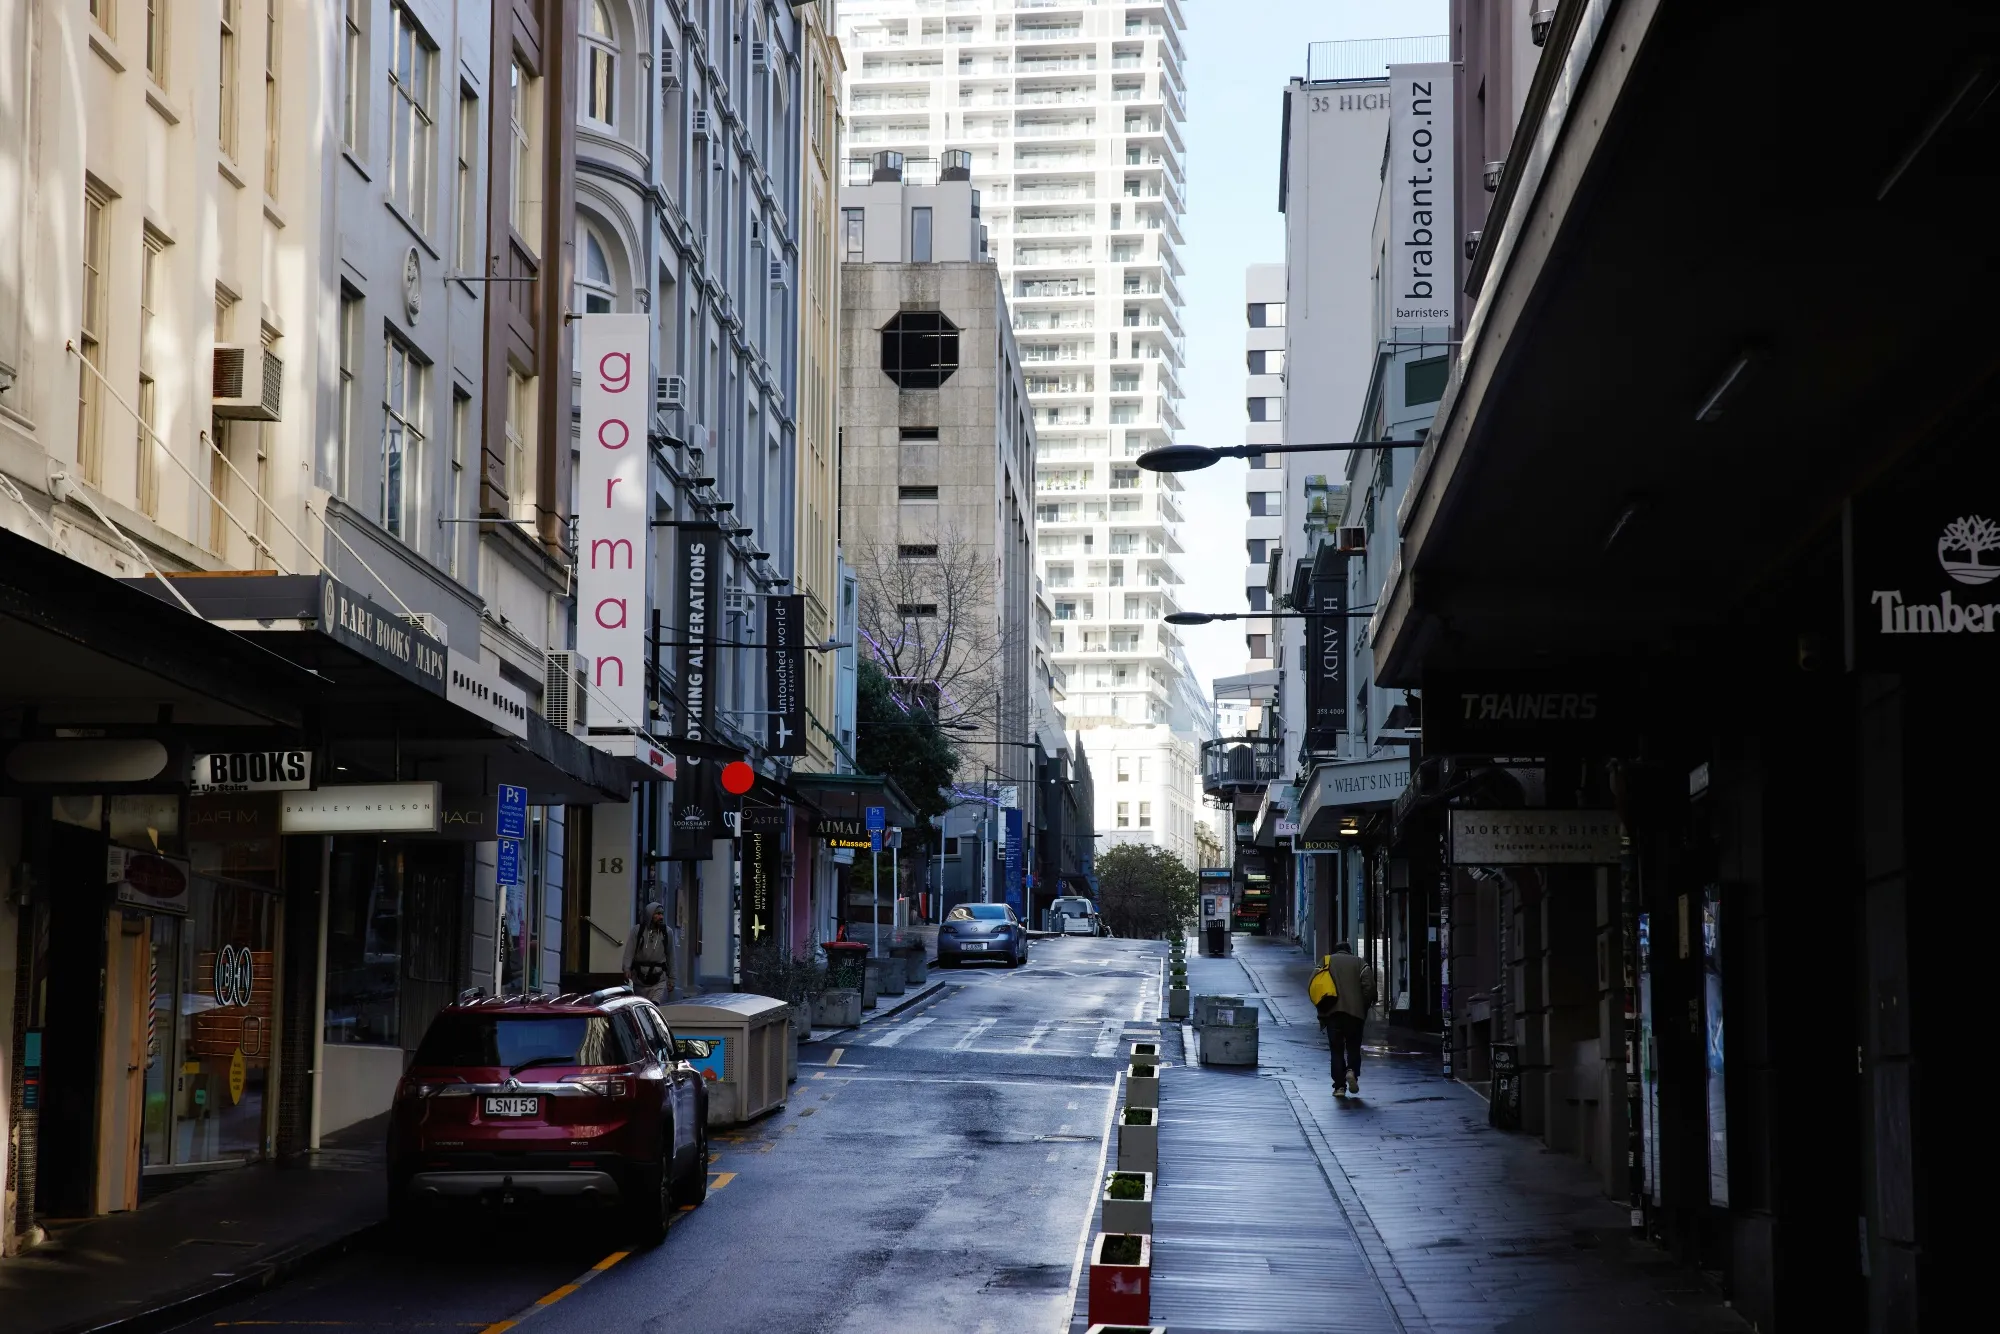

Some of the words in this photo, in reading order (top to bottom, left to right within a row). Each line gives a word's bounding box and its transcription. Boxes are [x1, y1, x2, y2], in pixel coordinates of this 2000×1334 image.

[1311, 96, 1330, 112] 35
[1339, 92, 1391, 111] HIGH
[1404, 81, 1433, 299] brabant.co.nz
[1396, 307, 1449, 319] barristers
[590, 351, 633, 687] gorman
[688, 542, 706, 669] ALTERATIONS
[1870, 589, 2000, 634] Timber
[340, 596, 373, 642] RARE
[375, 617, 410, 663] BOOKS
[415, 642, 444, 681] MAPS
[453, 670, 489, 700] BAILEY
[492, 691, 525, 720] NELSON
[776, 651, 787, 713] untouched
[686, 672, 704, 766] COTHING
[209, 752, 305, 783] BOOKS
[1334, 775, 1376, 793] WHAT'S
[1379, 773, 1392, 789] IN
[286, 805, 351, 813] BAILEY
[365, 803, 431, 811] NELSON
[816, 820, 861, 835] AIMAI
[1464, 825, 1558, 835] MORTIMER
[753, 833, 762, 860] world
[830, 838, 838, 847] &
[839, 839, 872, 849] Massage
[1304, 841, 1340, 850] BOOKS
[597, 857, 624, 874] 18
[753, 863, 762, 910] untouched
[486, 1099, 538, 1113] LSN153
